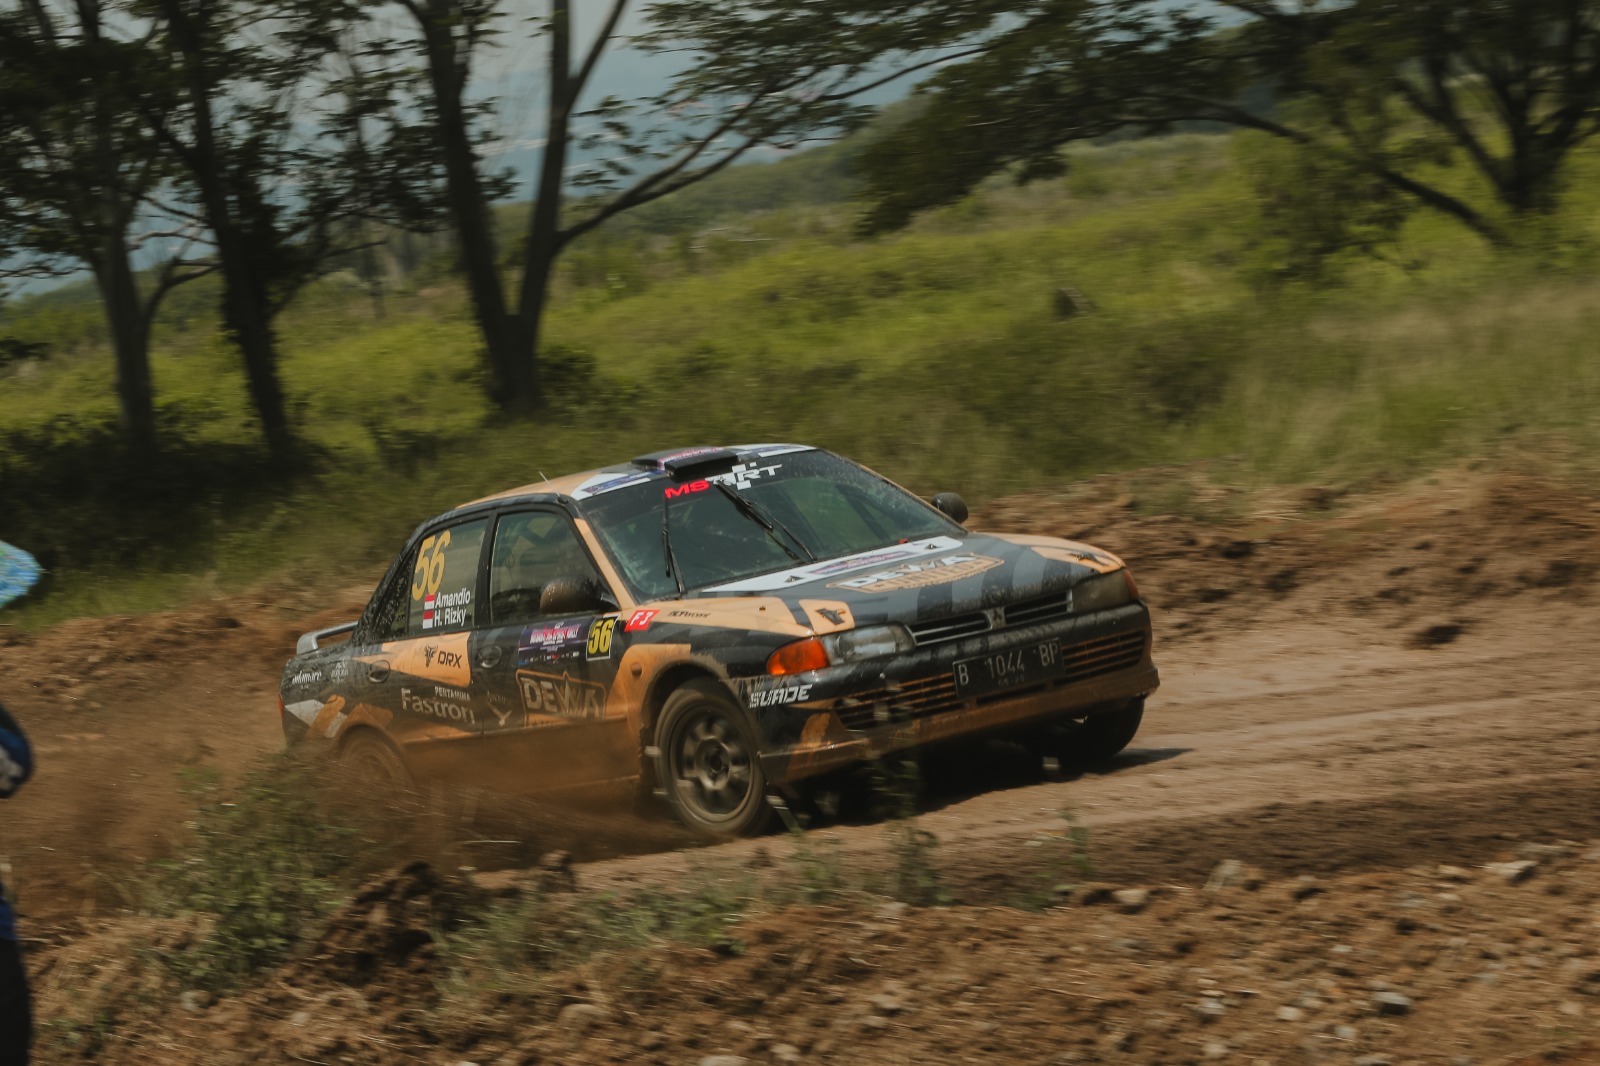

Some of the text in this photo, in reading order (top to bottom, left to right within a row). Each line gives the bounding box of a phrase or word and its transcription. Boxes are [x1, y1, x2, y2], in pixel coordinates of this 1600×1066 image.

[412, 529, 451, 601] 56
[434, 606, 467, 627] H. Rizky
[588, 618, 615, 654] 56
[958, 663, 969, 686] B
[984, 649, 1025, 679] 1044
[401, 687, 475, 725] Fastron
[520, 677, 600, 719] DEWA
